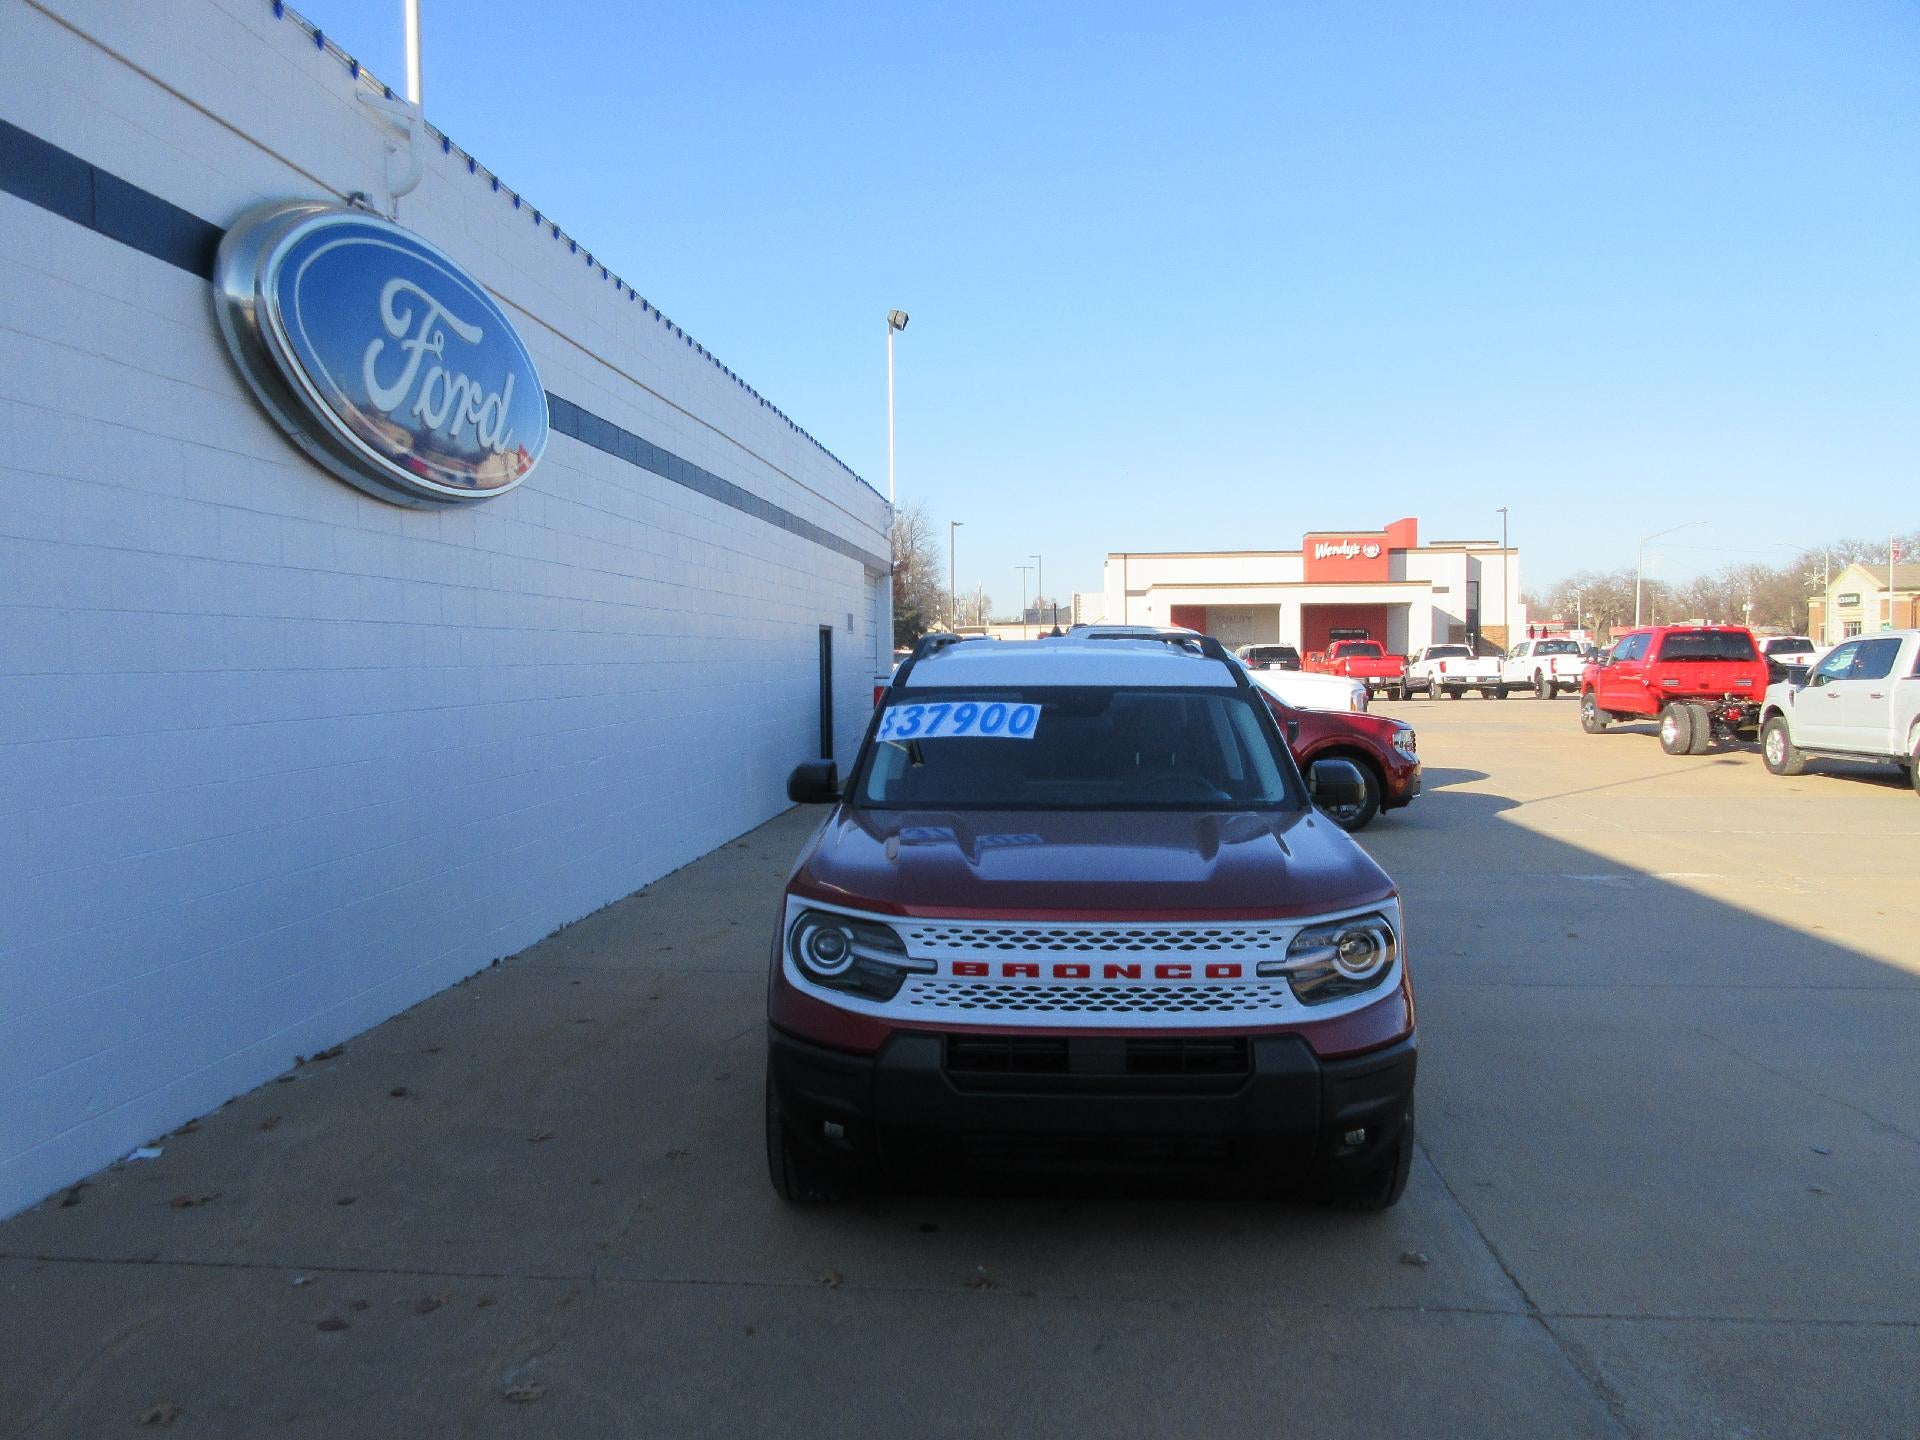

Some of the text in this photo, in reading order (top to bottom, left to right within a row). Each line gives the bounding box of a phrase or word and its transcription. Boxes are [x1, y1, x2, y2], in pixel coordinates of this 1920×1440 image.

[364, 278, 515, 454] Ford
[1315, 540, 1361, 560] Wendy's
[881, 703, 1036, 739] $37900
[952, 961, 1242, 979] BRONCO
